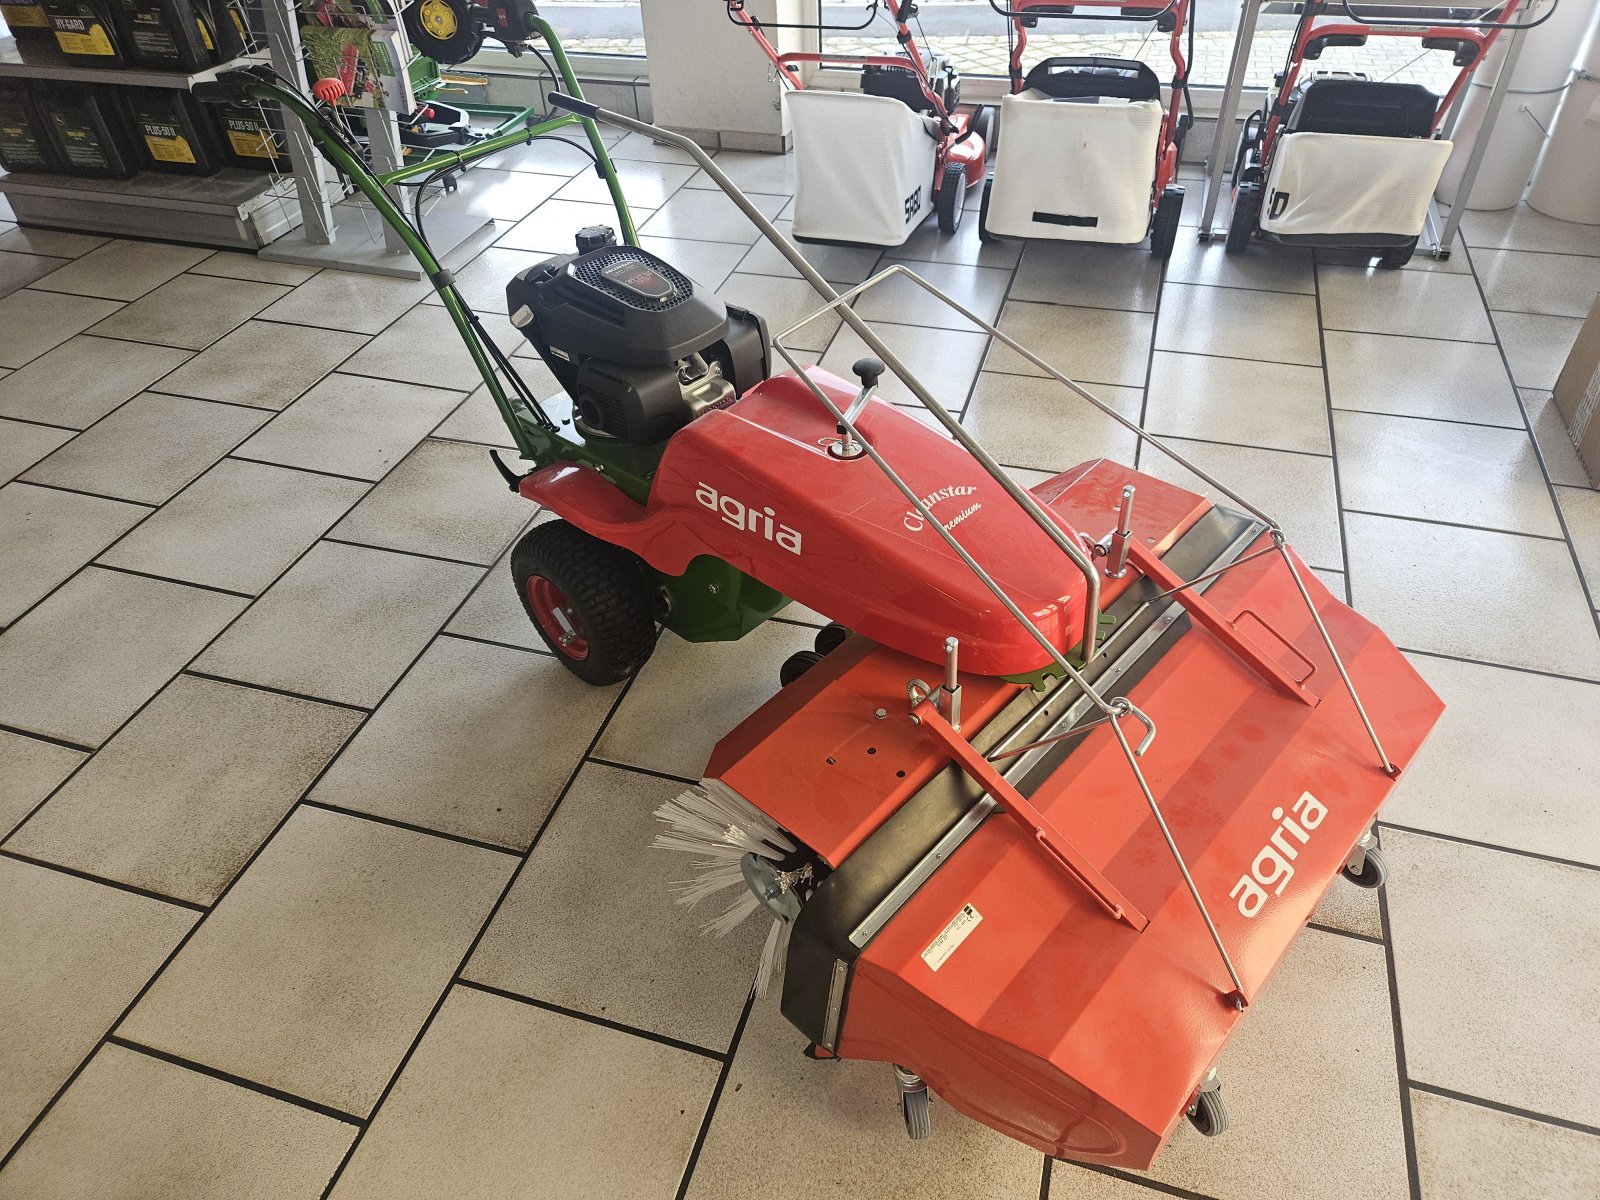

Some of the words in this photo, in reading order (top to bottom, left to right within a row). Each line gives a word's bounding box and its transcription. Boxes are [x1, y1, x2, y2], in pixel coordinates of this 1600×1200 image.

[55, 18, 86, 30] HY-GARD
[145, 125, 170, 136] PLUS-50
[228, 120, 254, 131] PLUS-50
[695, 481, 802, 555] agria
[942, 502, 982, 532] remium
[1228, 790, 1329, 918] agria
